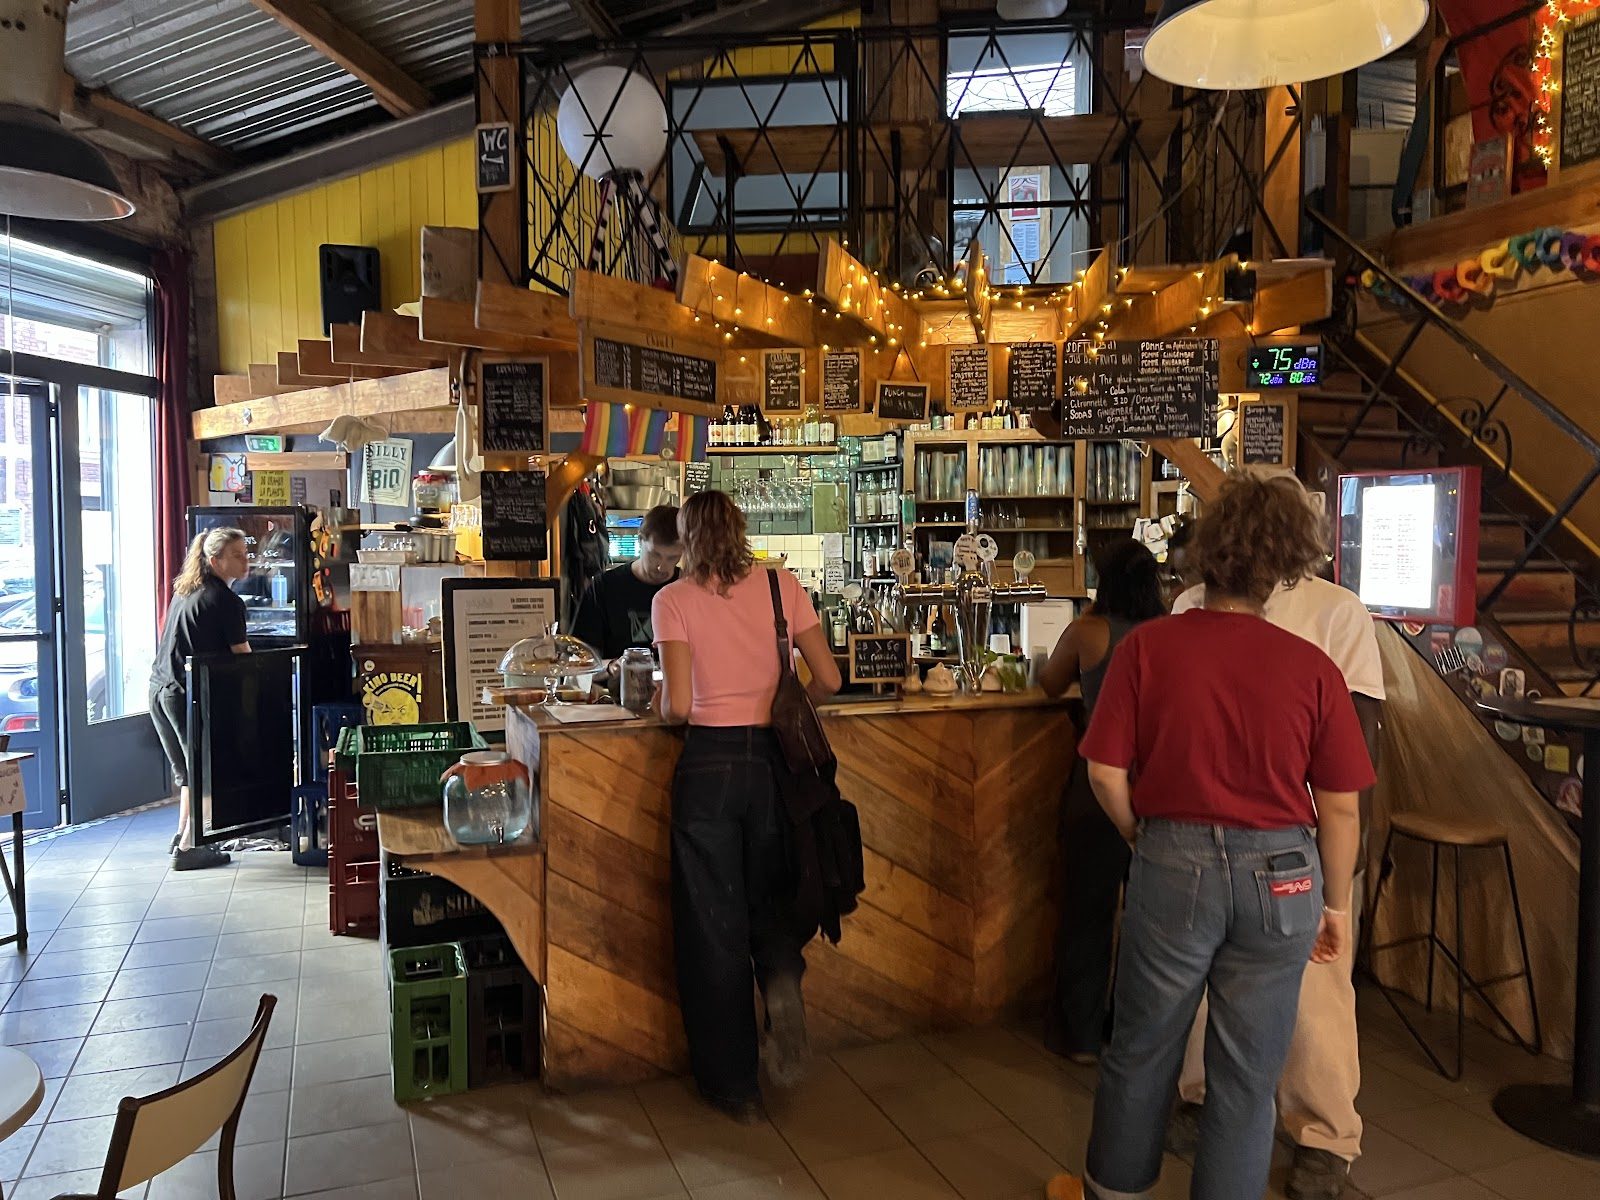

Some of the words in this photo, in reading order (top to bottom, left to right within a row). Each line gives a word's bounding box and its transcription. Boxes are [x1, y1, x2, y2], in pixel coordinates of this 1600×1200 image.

[482, 128, 507, 152] WC
[1141, 342, 1164, 351] POMME
[1268, 348, 1293, 371] 75
[1289, 372, 1304, 384] 80
[884, 387, 905, 397] PUNCH
[1069, 409, 1092, 420] SODAS
[366, 444, 406, 460] SILLY
[362, 673, 388, 692] KINO
